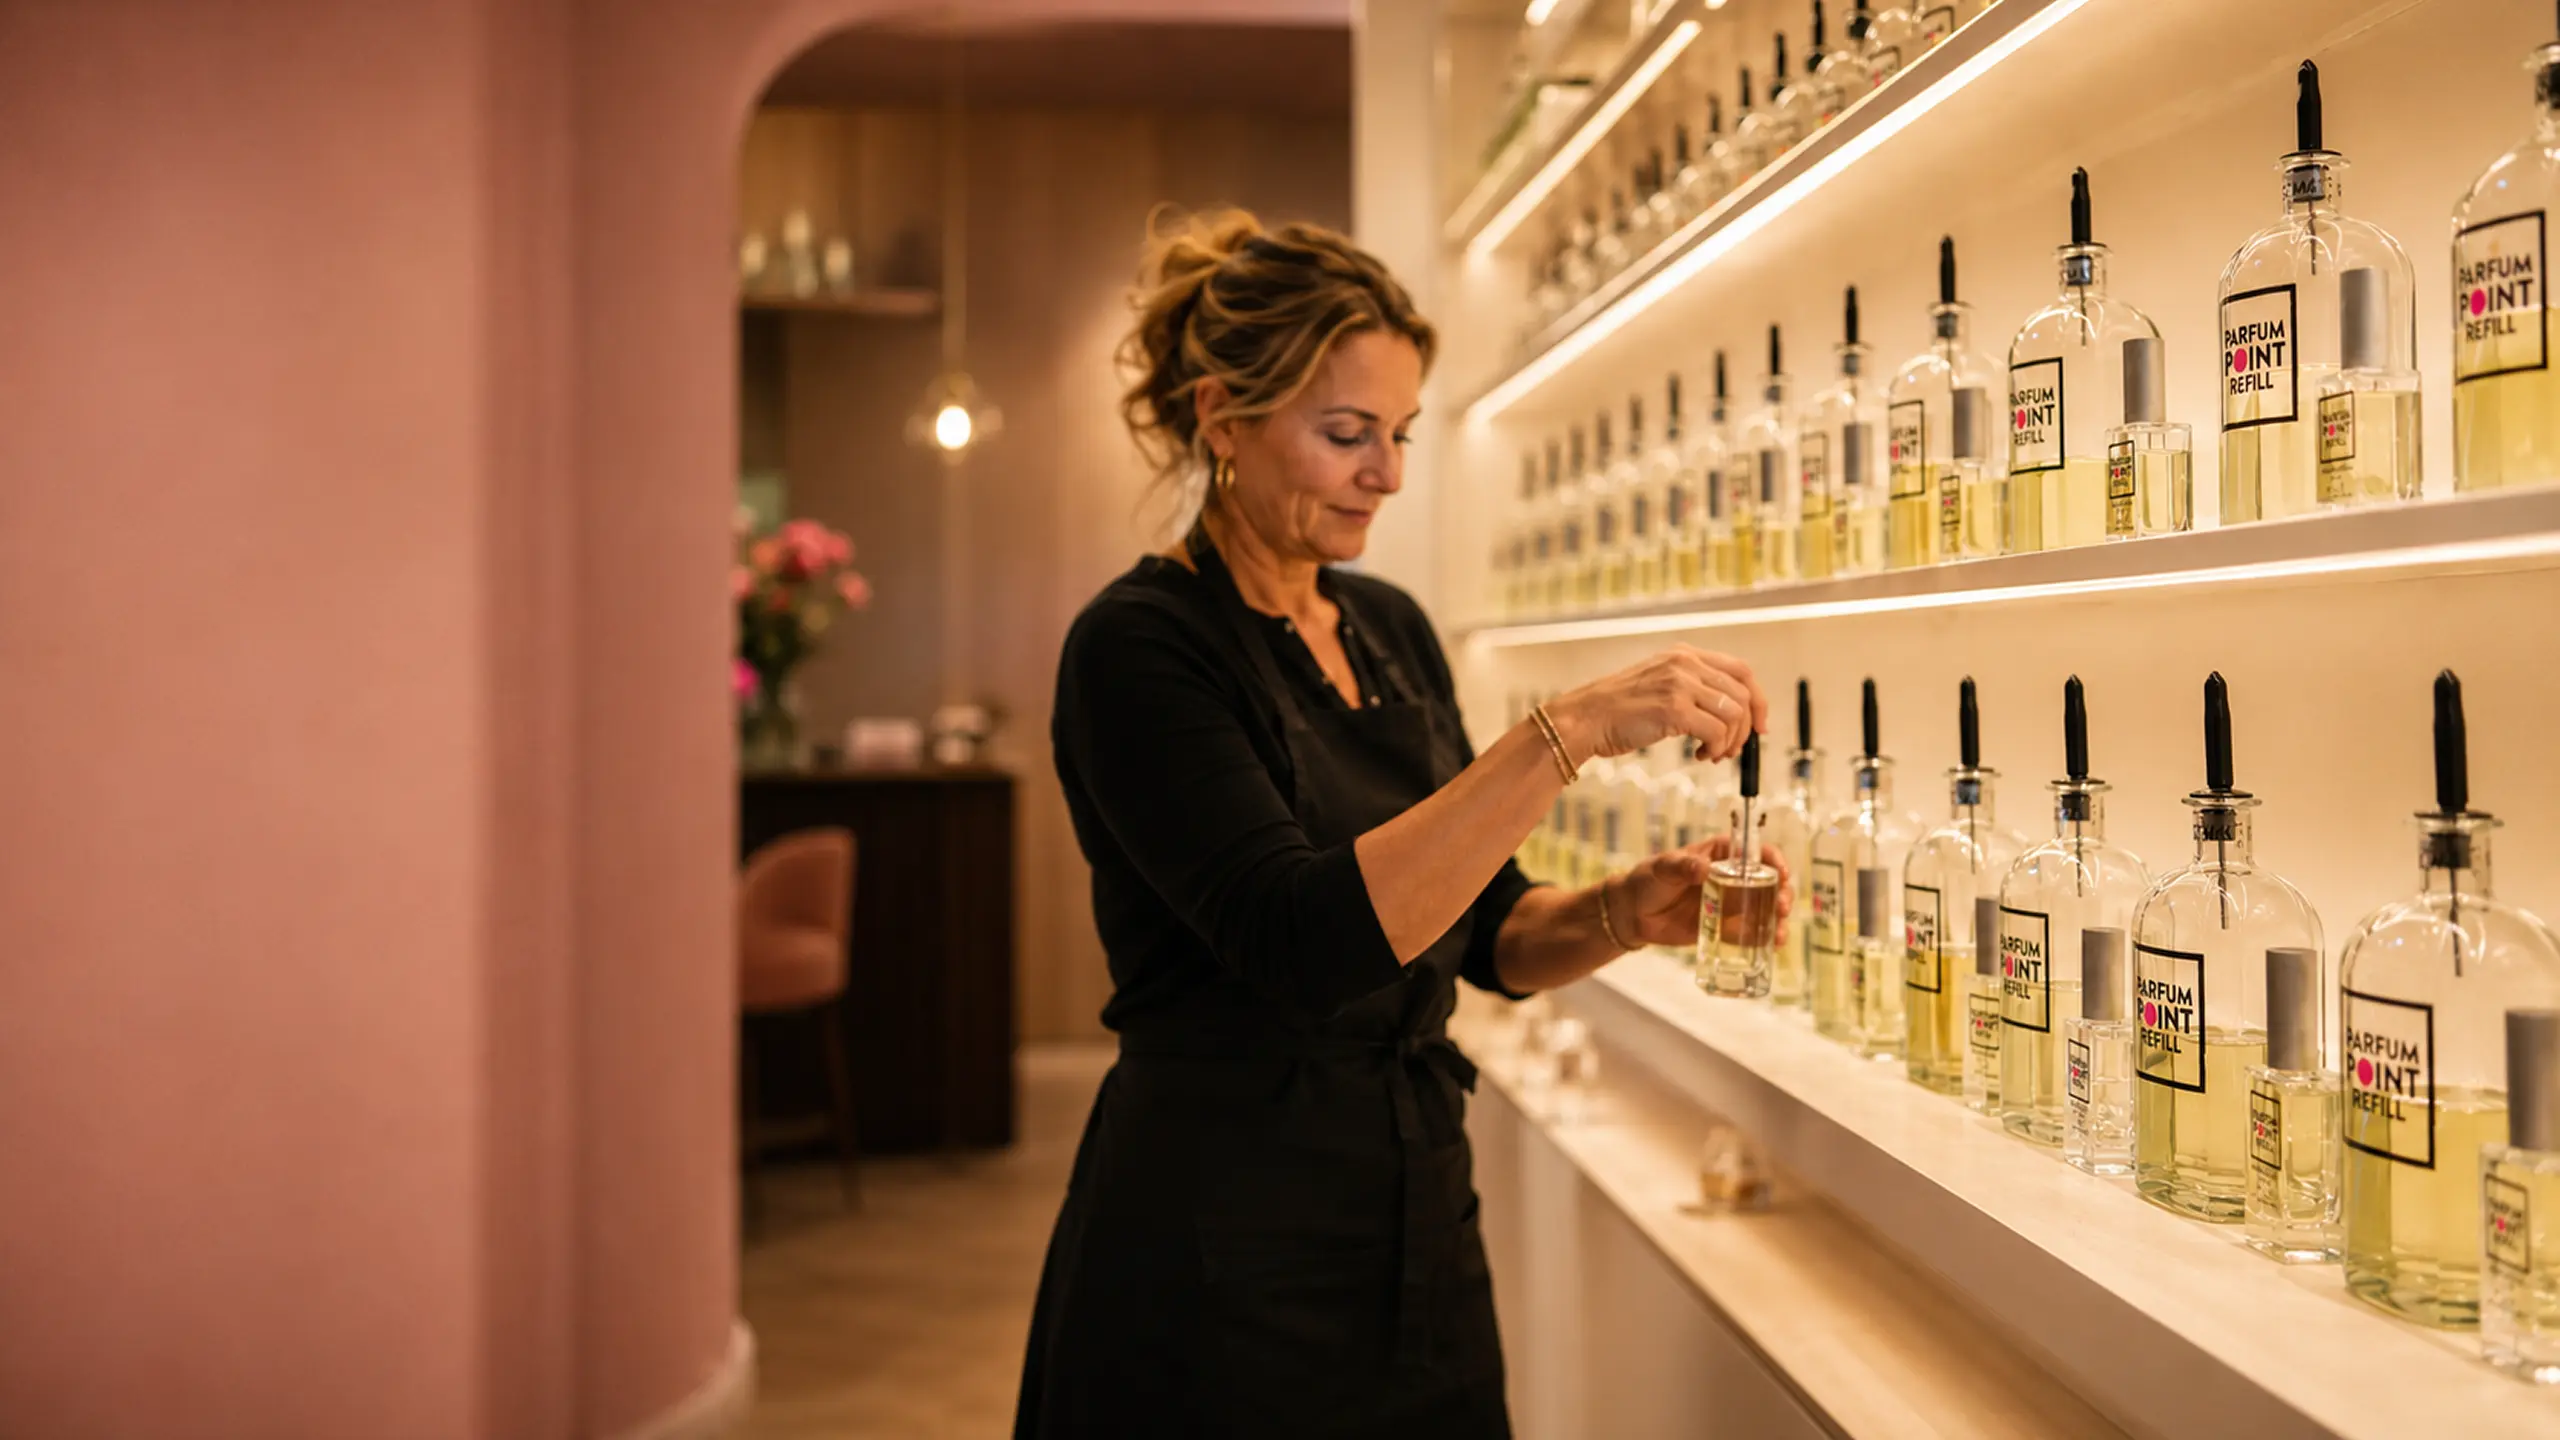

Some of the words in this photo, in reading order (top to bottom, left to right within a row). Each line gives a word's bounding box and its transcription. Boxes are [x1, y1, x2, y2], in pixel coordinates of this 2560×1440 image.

[2459, 254, 2532, 285] PARFUM
[2460, 278, 2533, 322] POINT
[2224, 319, 2285, 349] PARFUM
[2466, 314, 2516, 343] REFILL
[2225, 341, 2286, 377] POINT
[2230, 371, 2274, 395] REFILL
[2137, 976, 2193, 1006] PARFUM
[2137, 997, 2193, 1034] POINT
[2141, 1026, 2182, 1054] REFILL
[2347, 1025, 2420, 1064] PARFUM
[2347, 1052, 2421, 1098] POINT
[2352, 1088, 2406, 1121] REFILL
